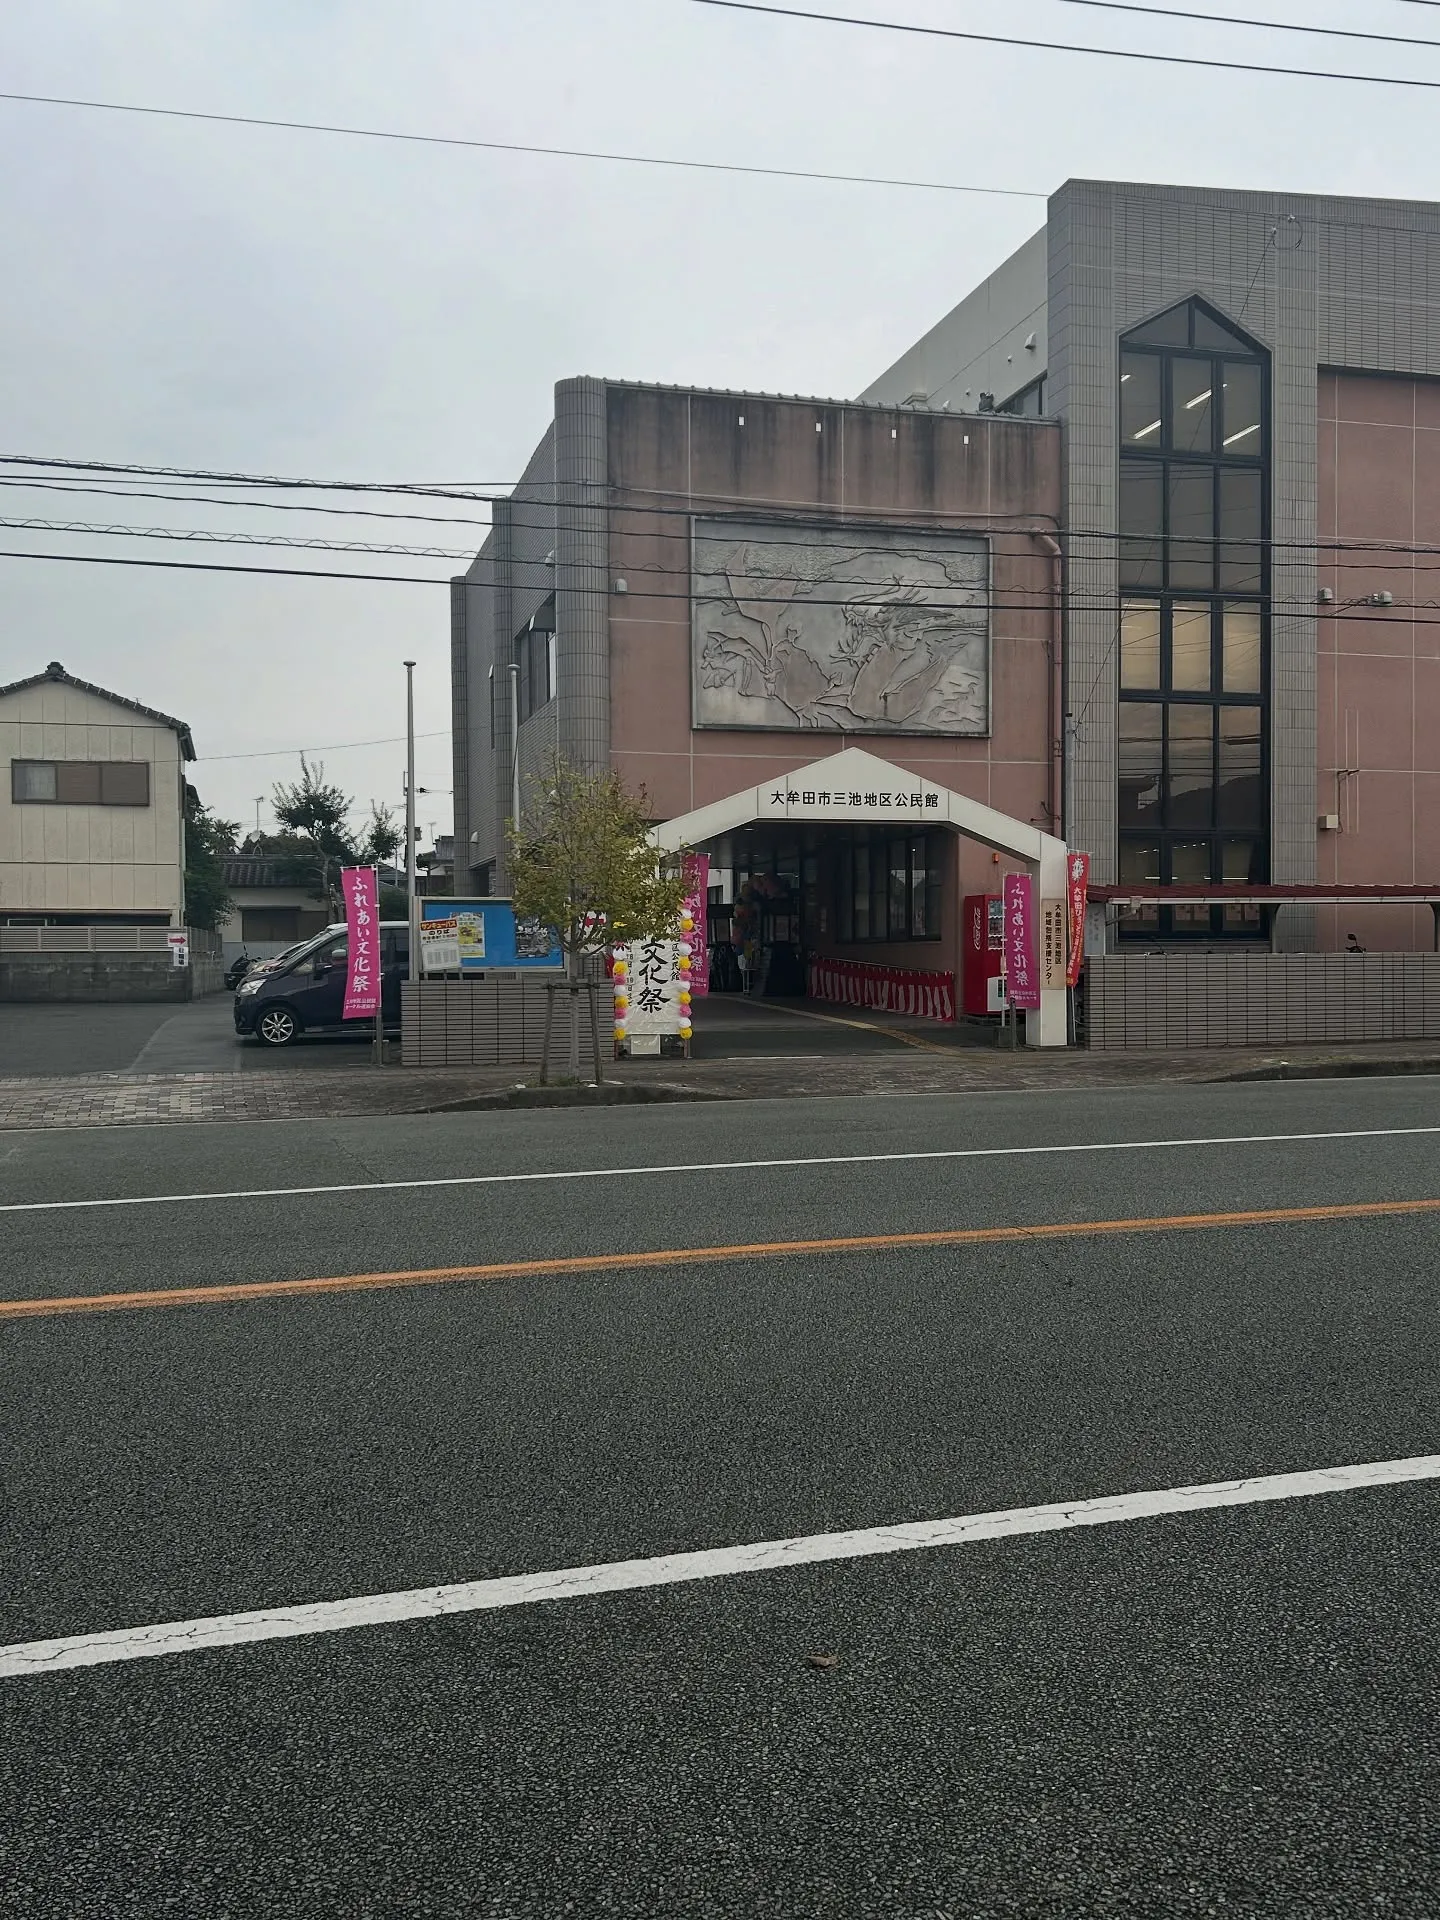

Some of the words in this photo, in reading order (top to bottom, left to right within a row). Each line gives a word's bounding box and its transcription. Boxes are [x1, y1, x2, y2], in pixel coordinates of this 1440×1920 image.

[770, 790, 939, 808] 大牟田市三池地区公民館
[352, 876, 371, 993] ふれあい文化祭
[1054, 903, 1062, 965] 大牟田市三池地区
[636, 938, 672, 1014] 文化祭
